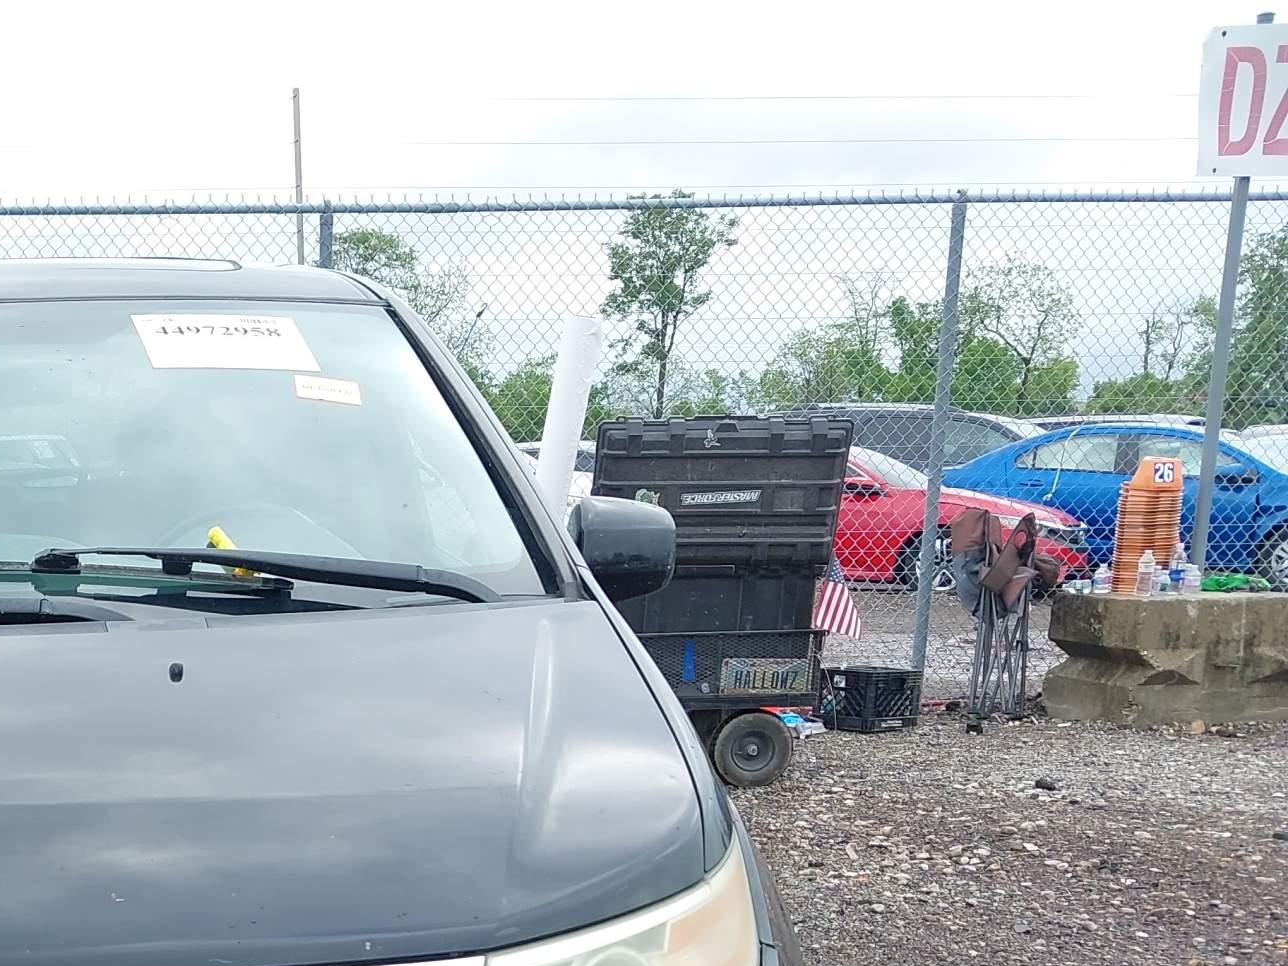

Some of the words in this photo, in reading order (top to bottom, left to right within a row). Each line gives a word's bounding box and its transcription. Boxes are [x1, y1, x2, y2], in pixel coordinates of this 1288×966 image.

[155, 326, 282, 337] 44972958
[1154, 463, 1174, 482] 26
[734, 670, 798, 689] HALLOWZ
